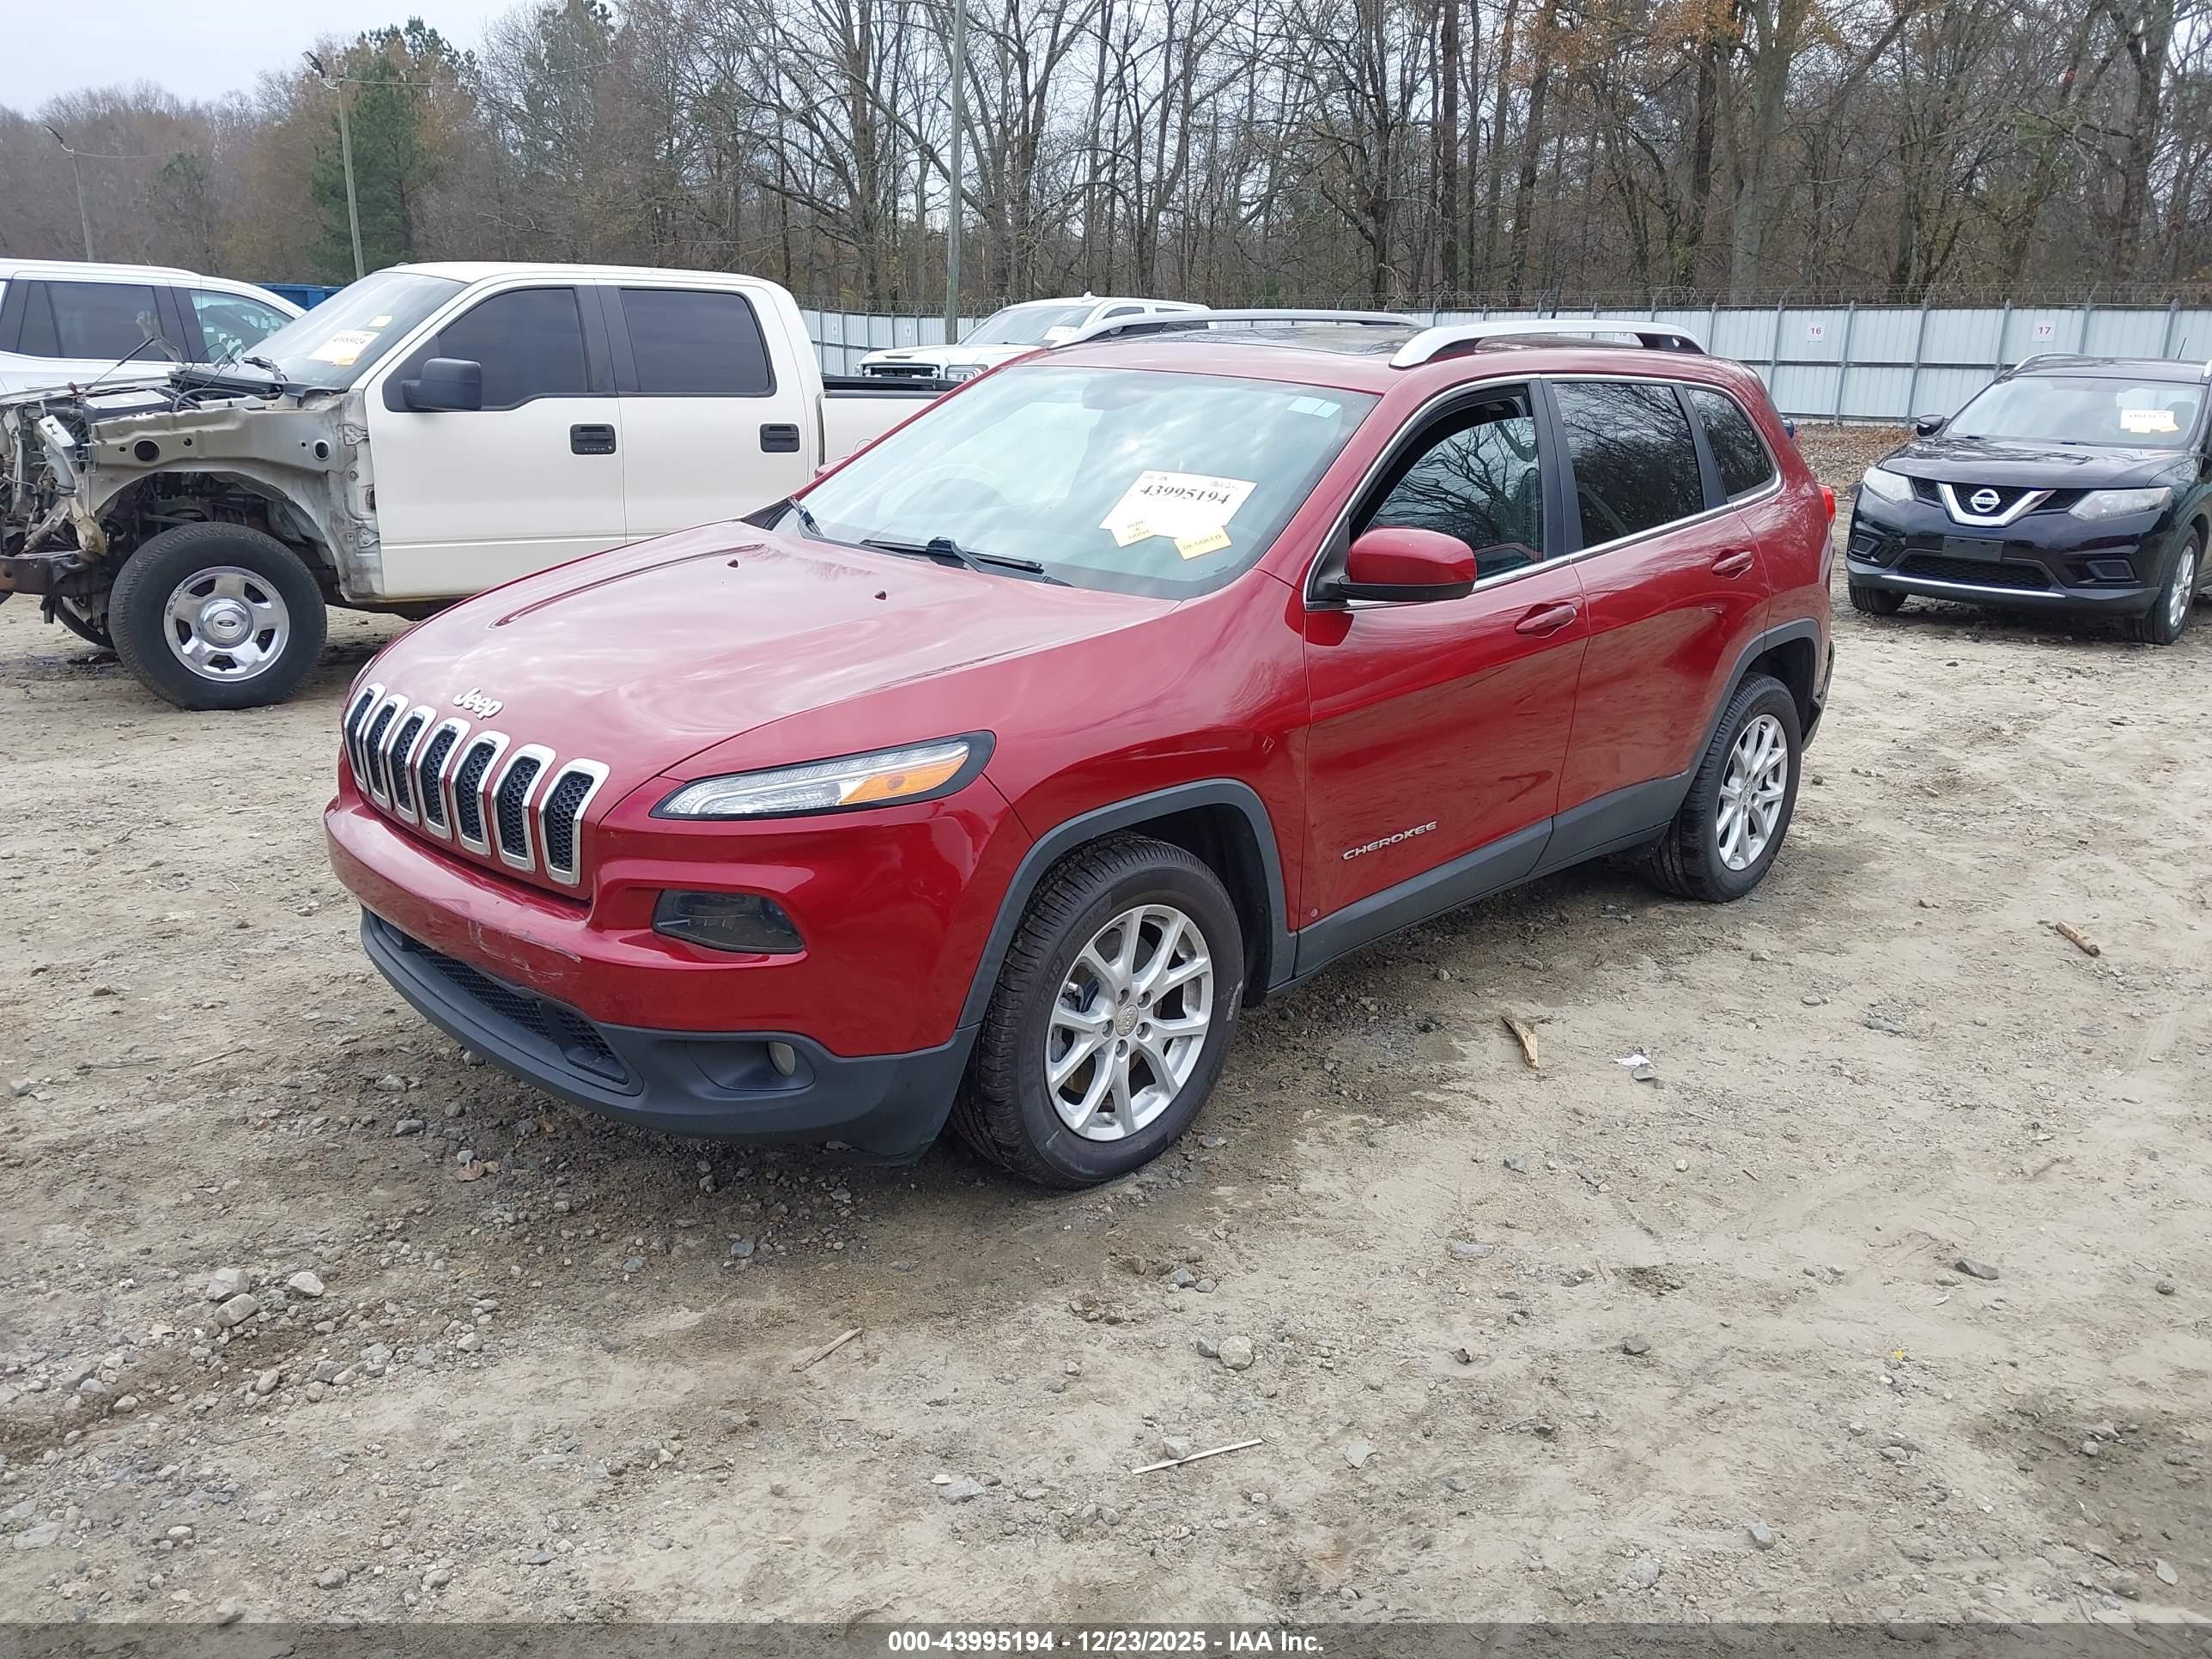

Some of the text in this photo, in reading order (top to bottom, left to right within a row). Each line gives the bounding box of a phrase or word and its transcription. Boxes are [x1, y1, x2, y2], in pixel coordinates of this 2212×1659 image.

[2039, 326, 2051, 335] 17
[1140, 484, 1231, 504] 43995194
[453, 687, 504, 720] Jeep
[1342, 821, 1437, 860] CHEROKEE
